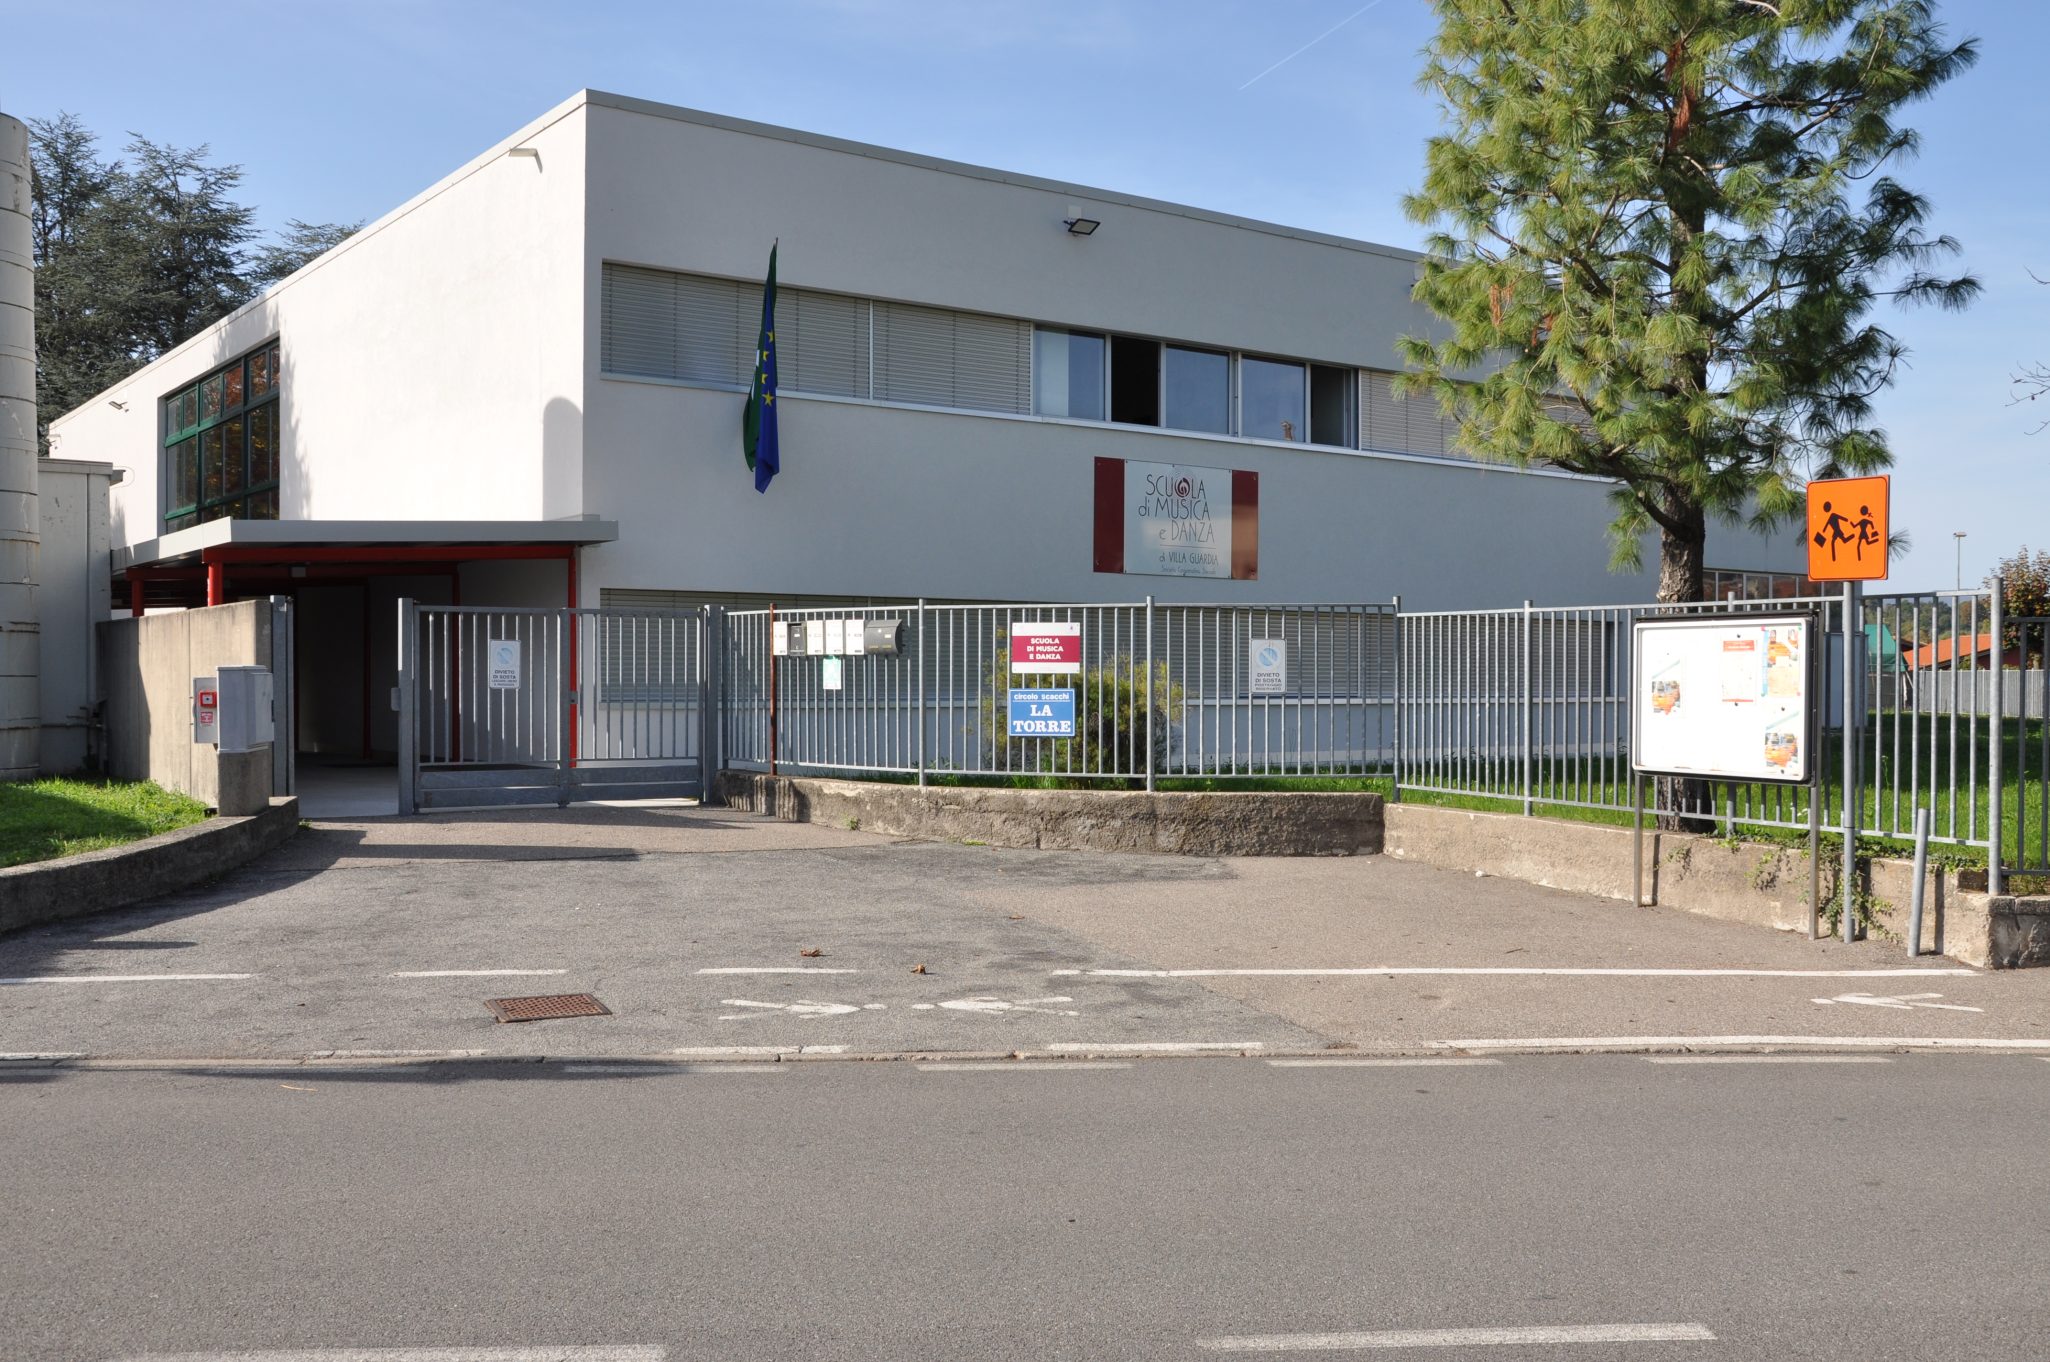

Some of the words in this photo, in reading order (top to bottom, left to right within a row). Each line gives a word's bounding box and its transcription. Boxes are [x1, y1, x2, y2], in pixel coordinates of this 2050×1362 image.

[1146, 474, 1206, 499] SCUOLA
[1138, 496, 1150, 517] di
[1155, 497, 1210, 521] MUSICA
[1159, 528, 1166, 540] e
[1171, 520, 1215, 543] DANZA
[1168, 551, 1187, 564] VILLA
[1189, 552, 1219, 566] GUARDIA
[1013, 692, 1039, 700] circolo
[1041, 692, 1070, 700] scacchi
[1030, 704, 1053, 717] LA
[1012, 720, 1071, 733] TORRE
